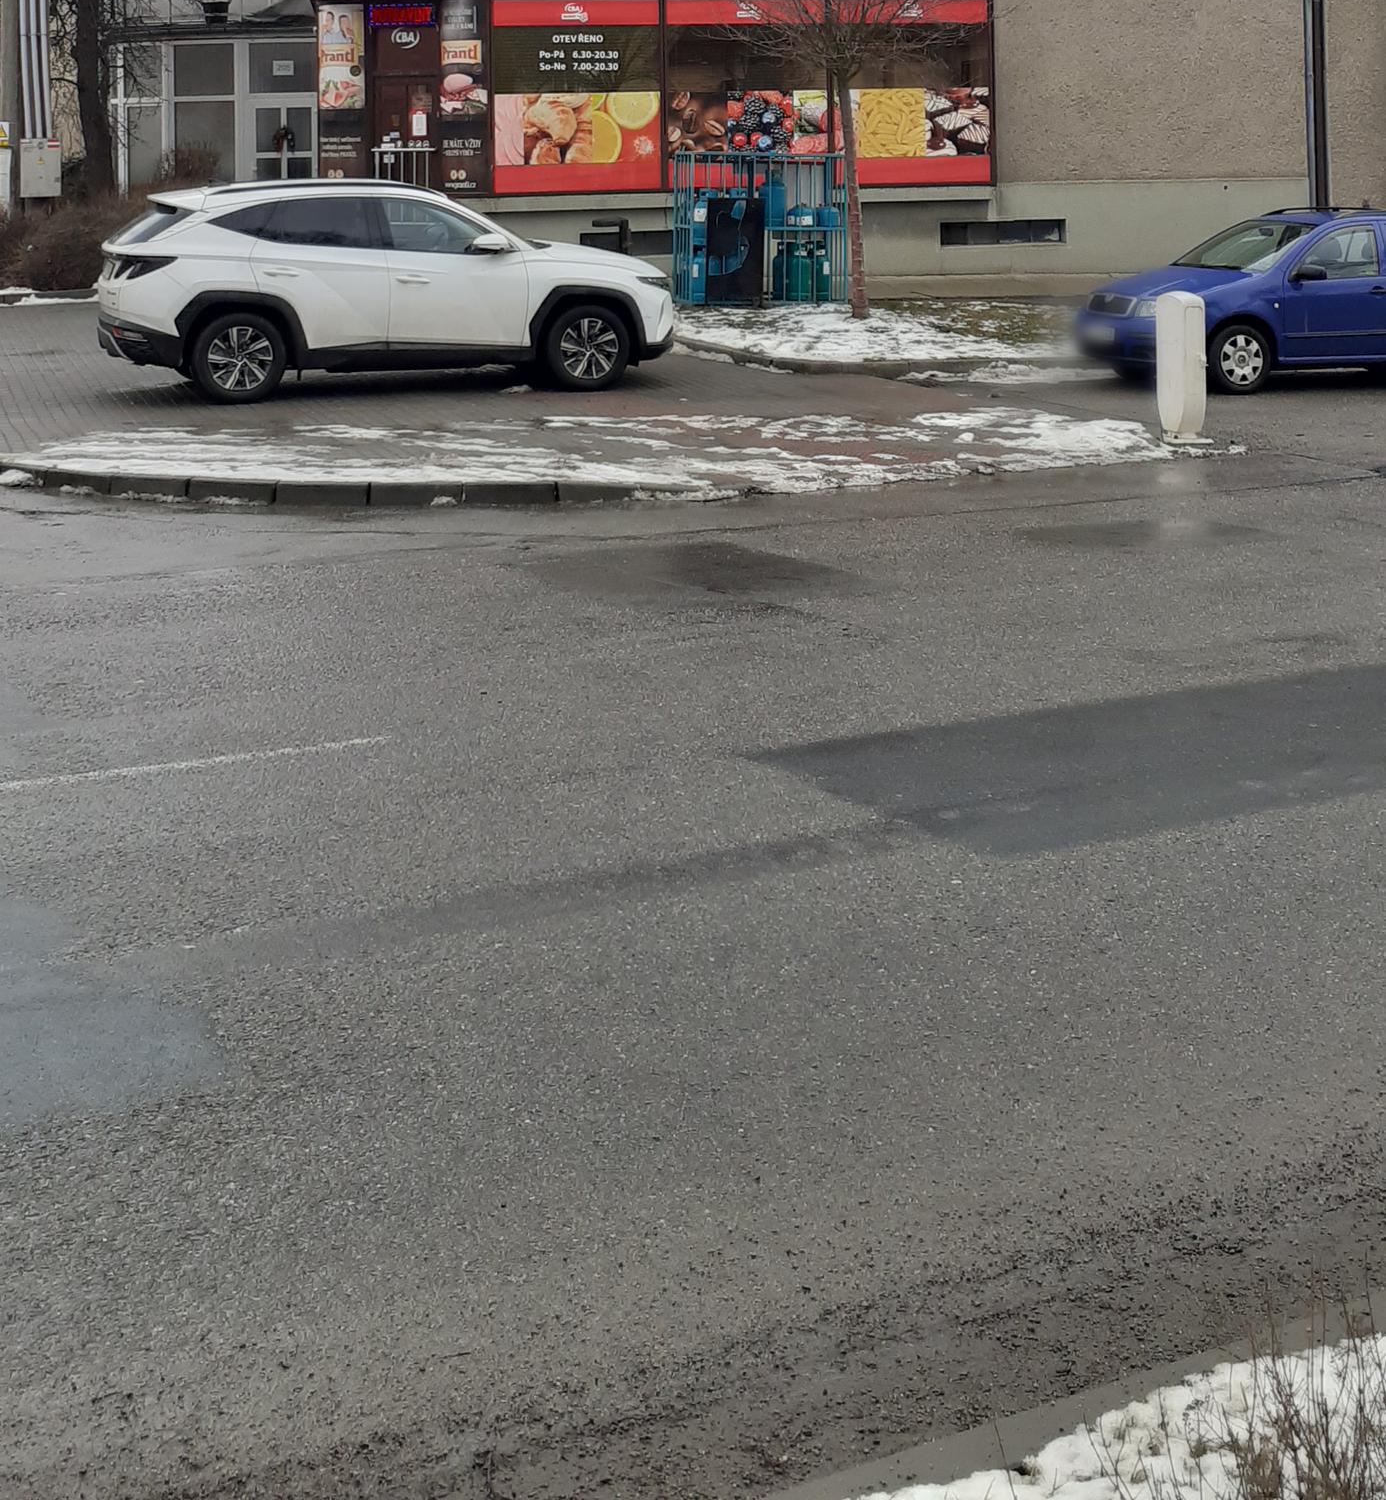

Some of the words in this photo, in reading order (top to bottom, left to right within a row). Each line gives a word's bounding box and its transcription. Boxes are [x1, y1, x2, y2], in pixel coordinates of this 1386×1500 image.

[395, 31, 416, 43] CBA
[552, 33, 604, 43] OTEVŘENO
[539, 49, 565, 59] Po-Pá
[572, 50, 619, 59] 6.30-20.30
[539, 62, 567, 71] So-Ne
[572, 62, 619, 71] 7.00-20.30
